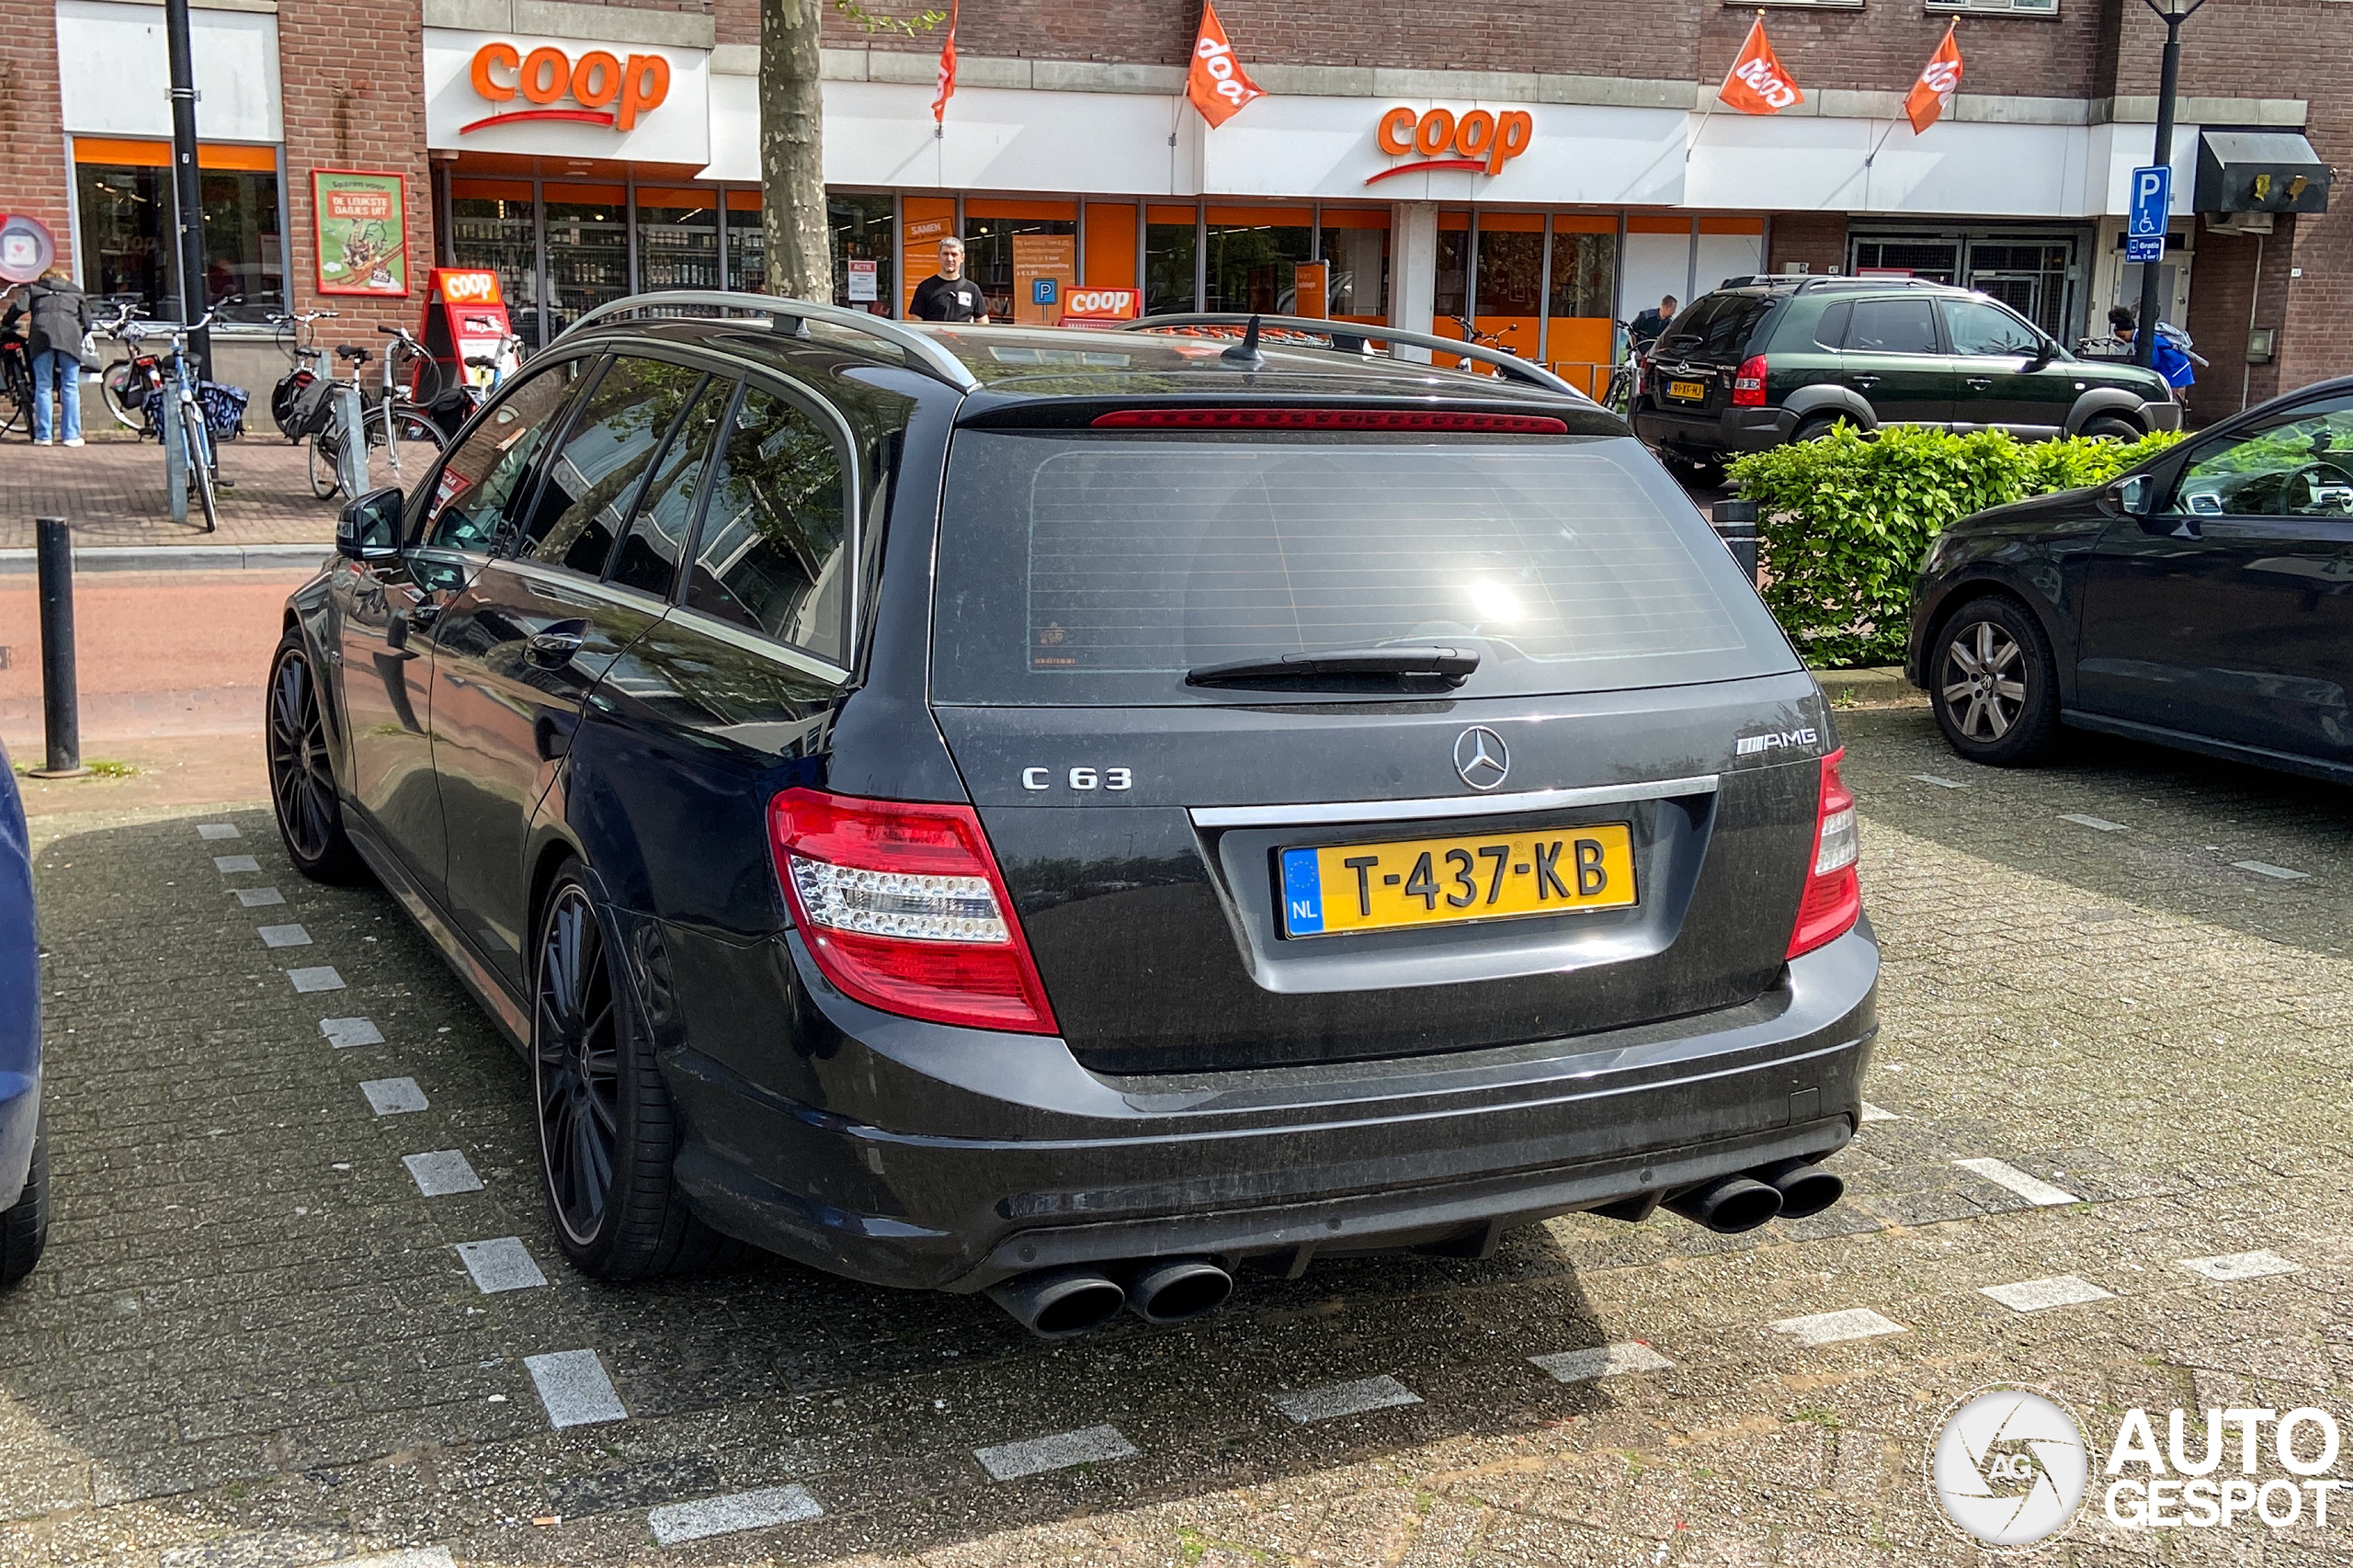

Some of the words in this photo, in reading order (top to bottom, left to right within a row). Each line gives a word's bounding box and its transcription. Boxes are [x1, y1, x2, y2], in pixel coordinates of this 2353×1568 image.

[471, 42, 671, 131] coop
[1376, 107, 1533, 176] coop
[333, 197, 346, 205] DE
[2139, 174, 2160, 209] P
[370, 207, 387, 215] UIT
[911, 222, 942, 235] SAMEN
[448, 273, 492, 300] coop
[1071, 291, 1130, 314] coop
[1764, 728, 1817, 751] AMG
[1022, 767, 1050, 790] C
[1068, 767, 1132, 790] 63
[1344, 838, 1608, 917] T-437-KB
[1292, 901, 1318, 920] NL
